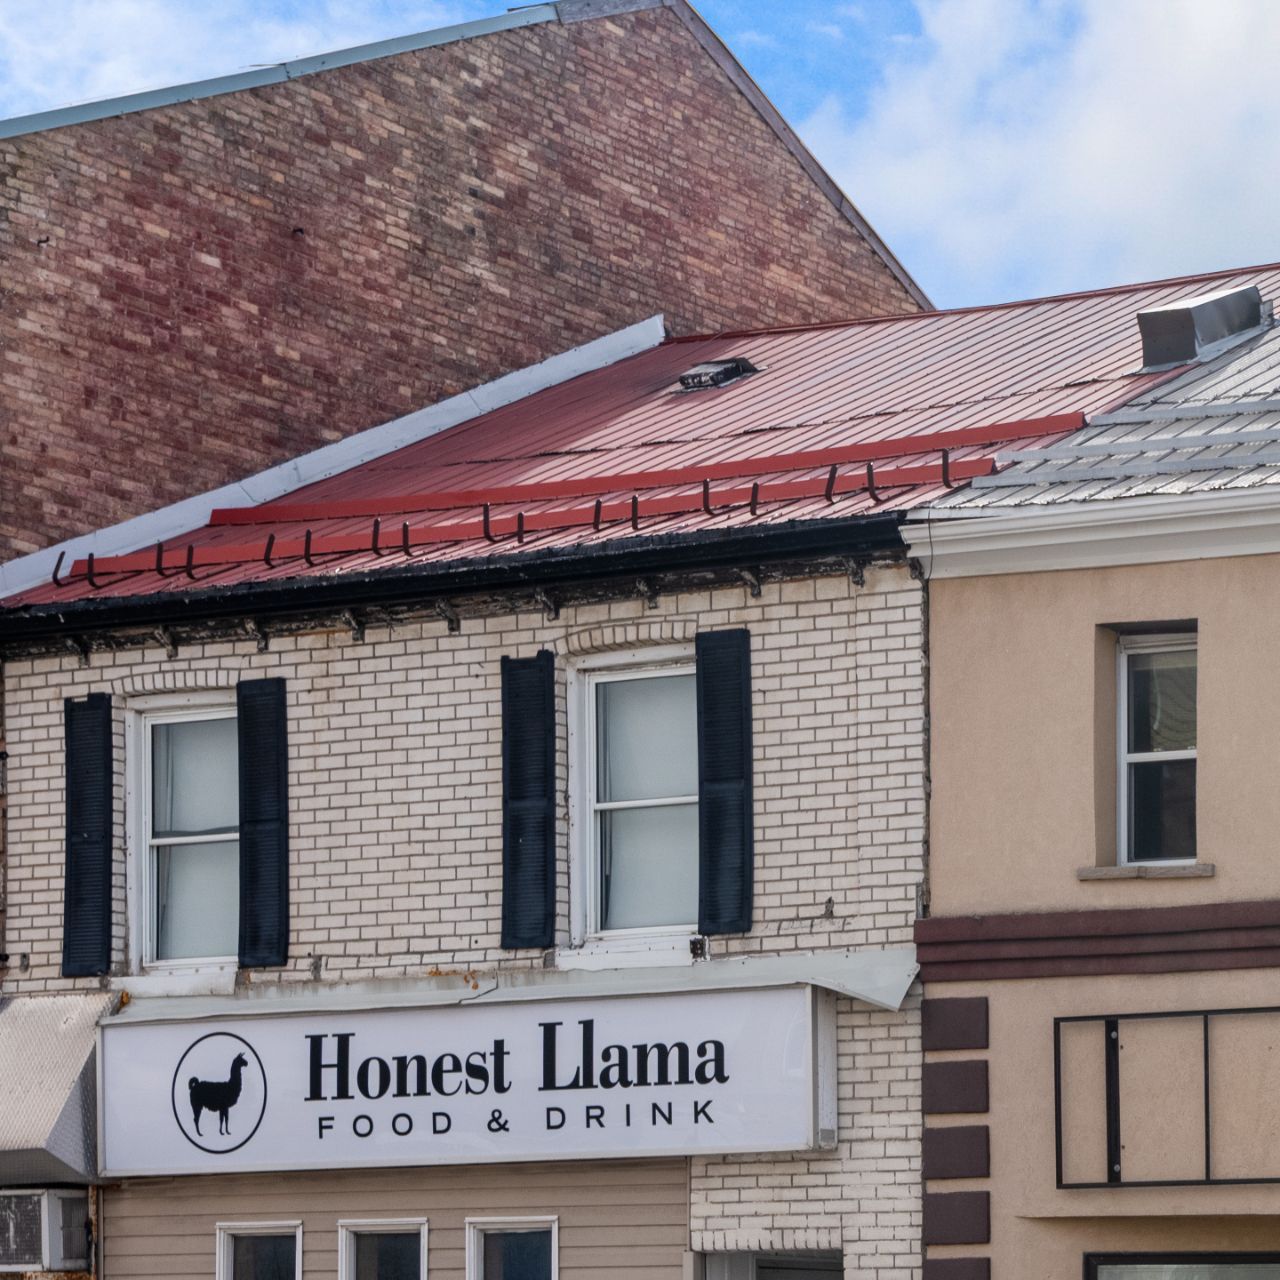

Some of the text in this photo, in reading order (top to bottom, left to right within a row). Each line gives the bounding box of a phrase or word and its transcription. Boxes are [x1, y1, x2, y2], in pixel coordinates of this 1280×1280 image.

[304, 1018, 730, 1102] Honest Llama
[318, 1100, 715, 1139] FOOD & DRINK
